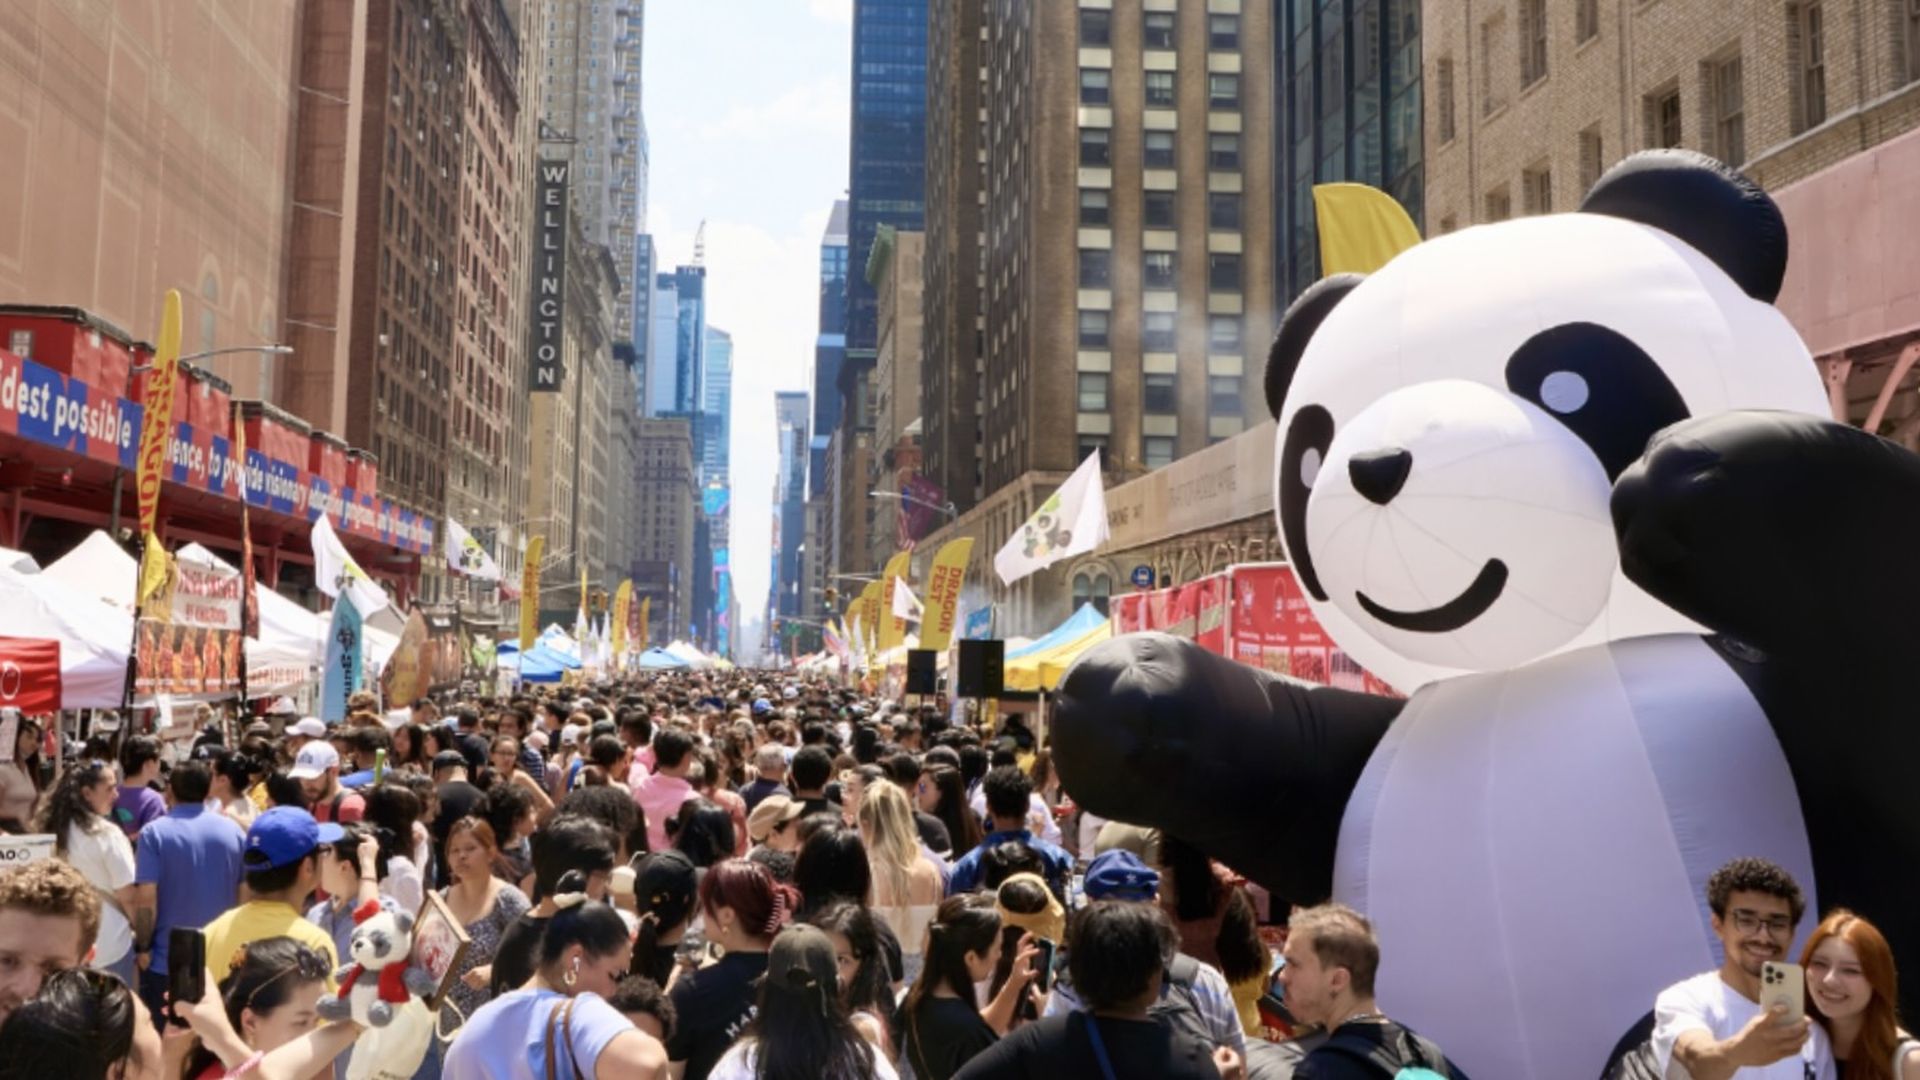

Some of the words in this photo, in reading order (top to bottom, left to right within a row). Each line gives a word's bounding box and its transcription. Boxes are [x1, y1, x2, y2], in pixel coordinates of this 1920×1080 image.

[538, 166, 567, 385] WELLINGTON
[53, 395, 131, 448] possible
[208, 446, 221, 478] to
[930, 564, 948, 603] FEST
[938, 567, 962, 634] DRAGON
